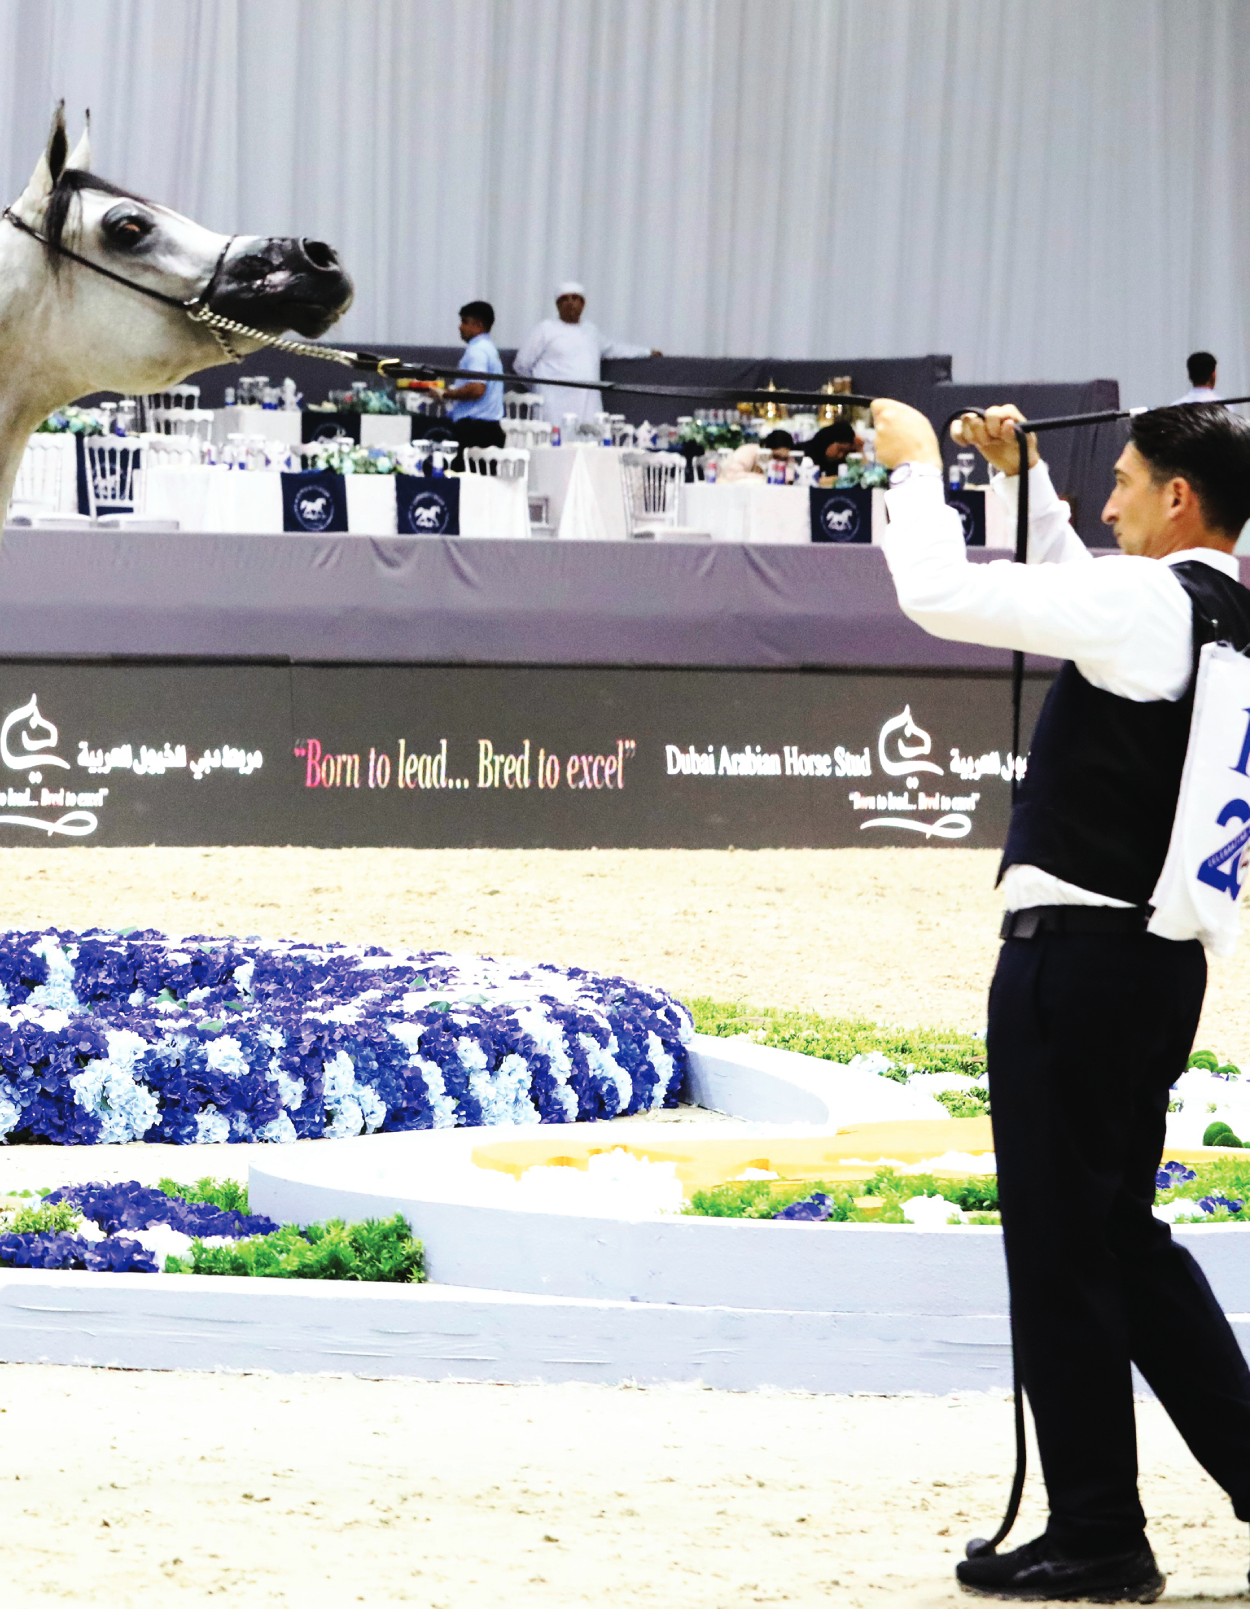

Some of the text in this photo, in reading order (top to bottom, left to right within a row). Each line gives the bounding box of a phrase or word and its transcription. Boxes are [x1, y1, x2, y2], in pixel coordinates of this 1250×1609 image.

[77, 741, 132, 774] العربية
[189, 749, 221, 780] دبي
[368, 748, 391, 788] to
[398, 739, 469, 789] lead...
[477, 739, 530, 789] Bred
[538, 748, 560, 789] to
[665, 745, 872, 777] Dubai Arabian Horse Stud
[950, 748, 1000, 780] العربية
